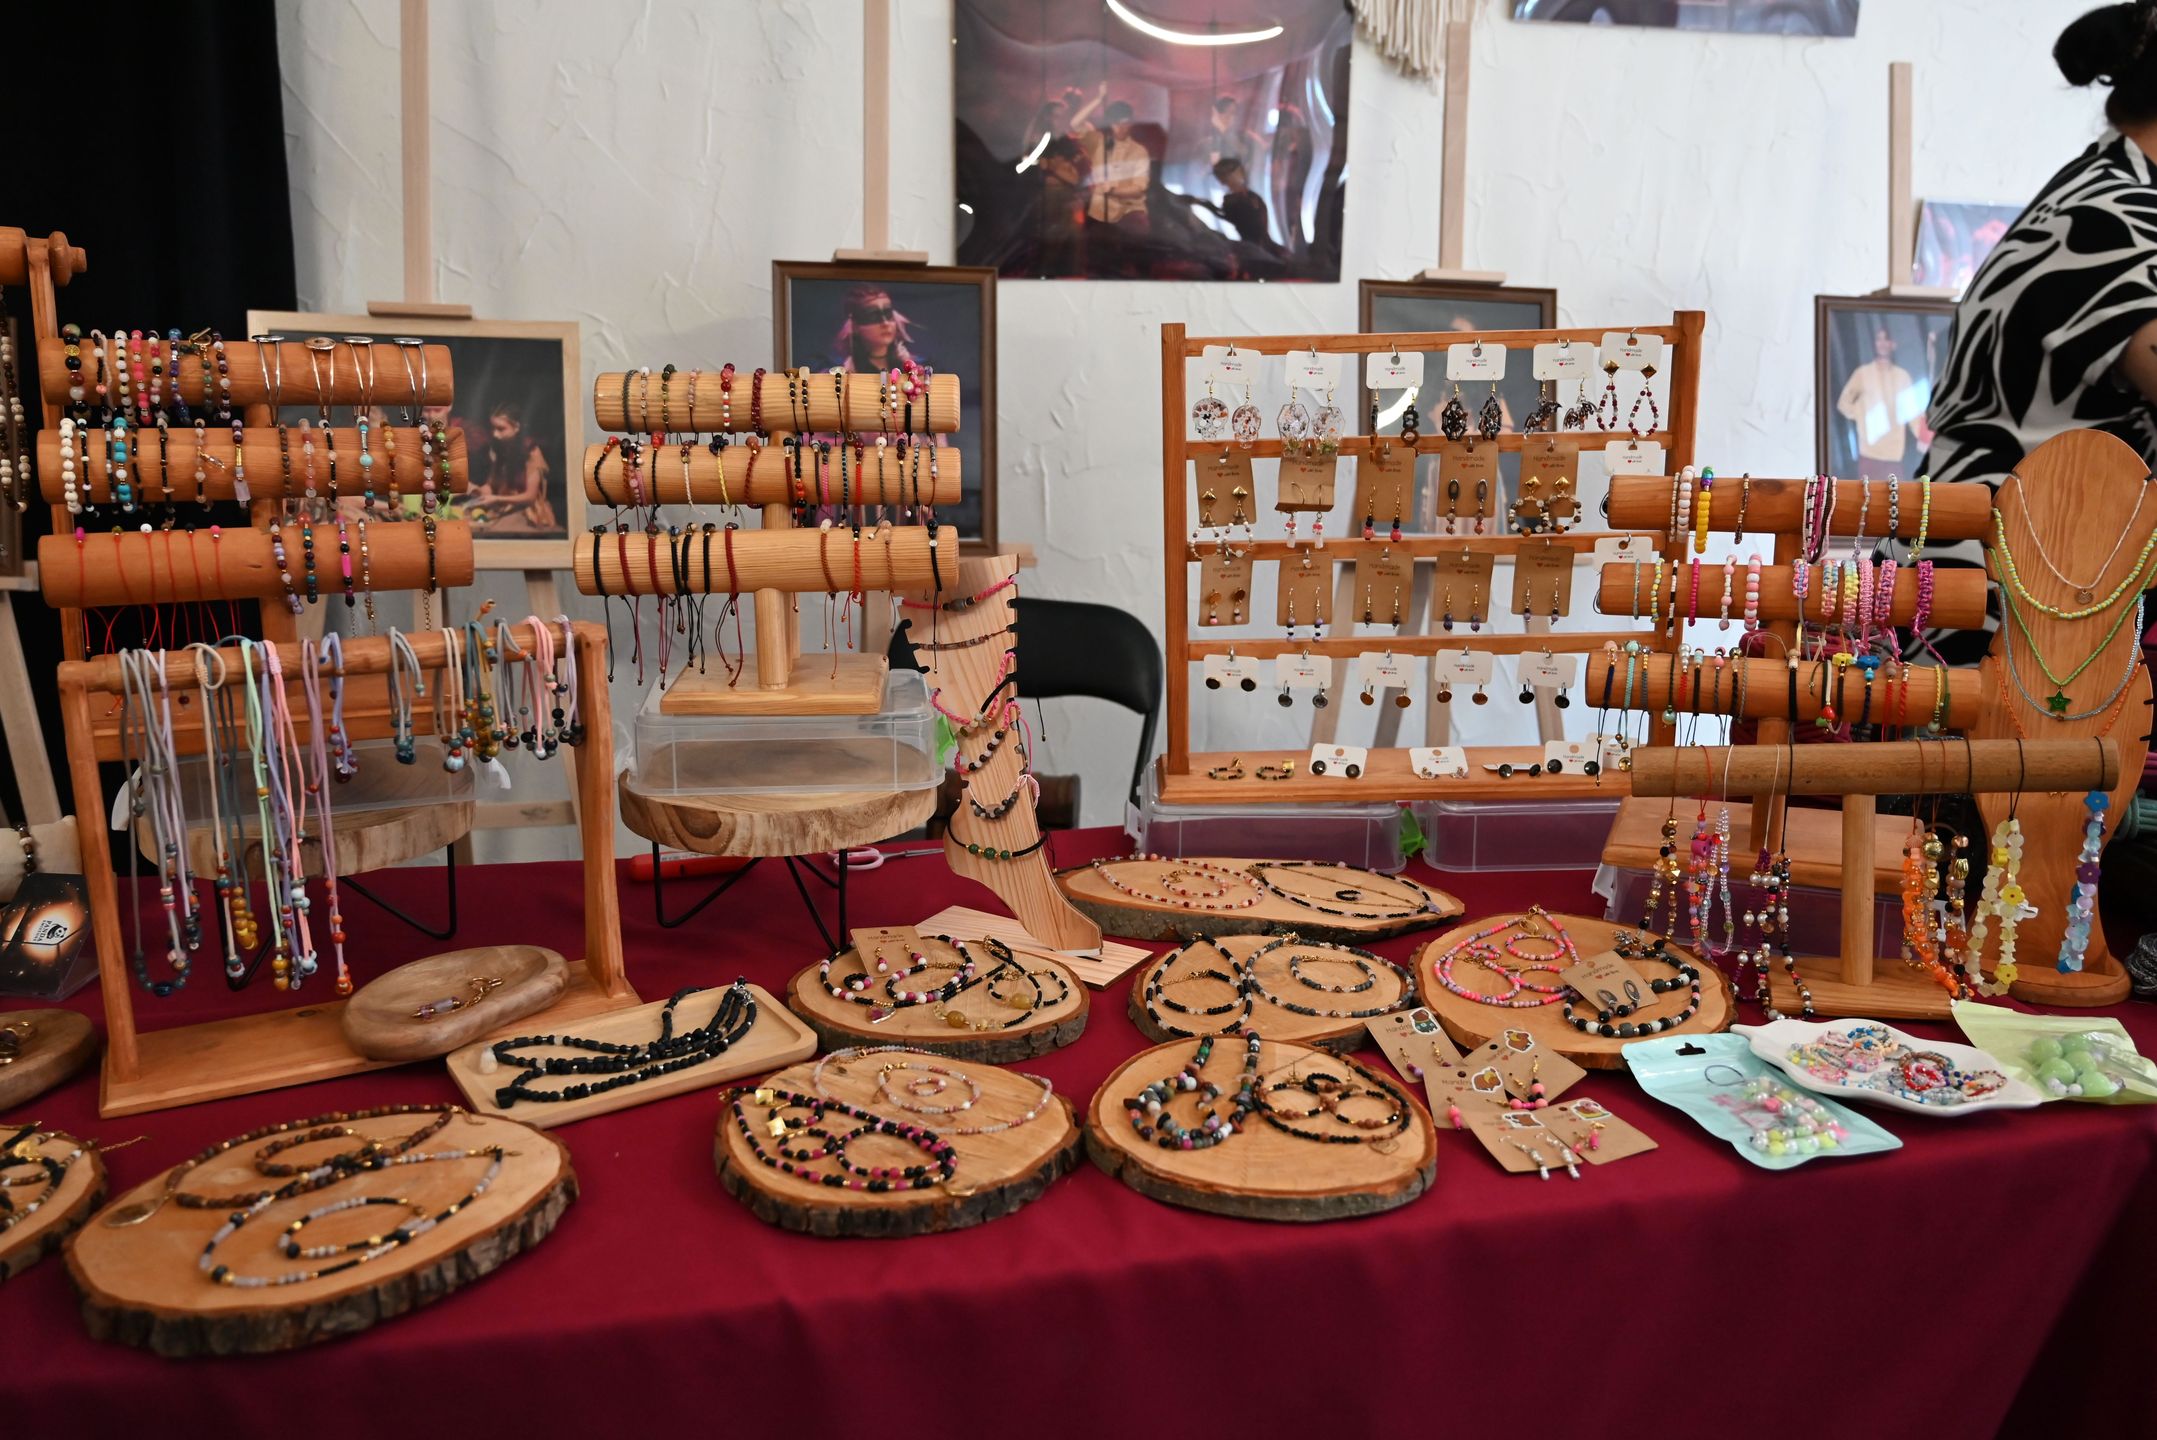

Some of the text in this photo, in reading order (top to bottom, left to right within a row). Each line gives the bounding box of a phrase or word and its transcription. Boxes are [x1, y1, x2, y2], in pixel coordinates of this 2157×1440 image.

[1208, 464, 1239, 472] Handmade
[37, 920, 52, 942] PANDA
[1581, 963, 1614, 978] Handmade
